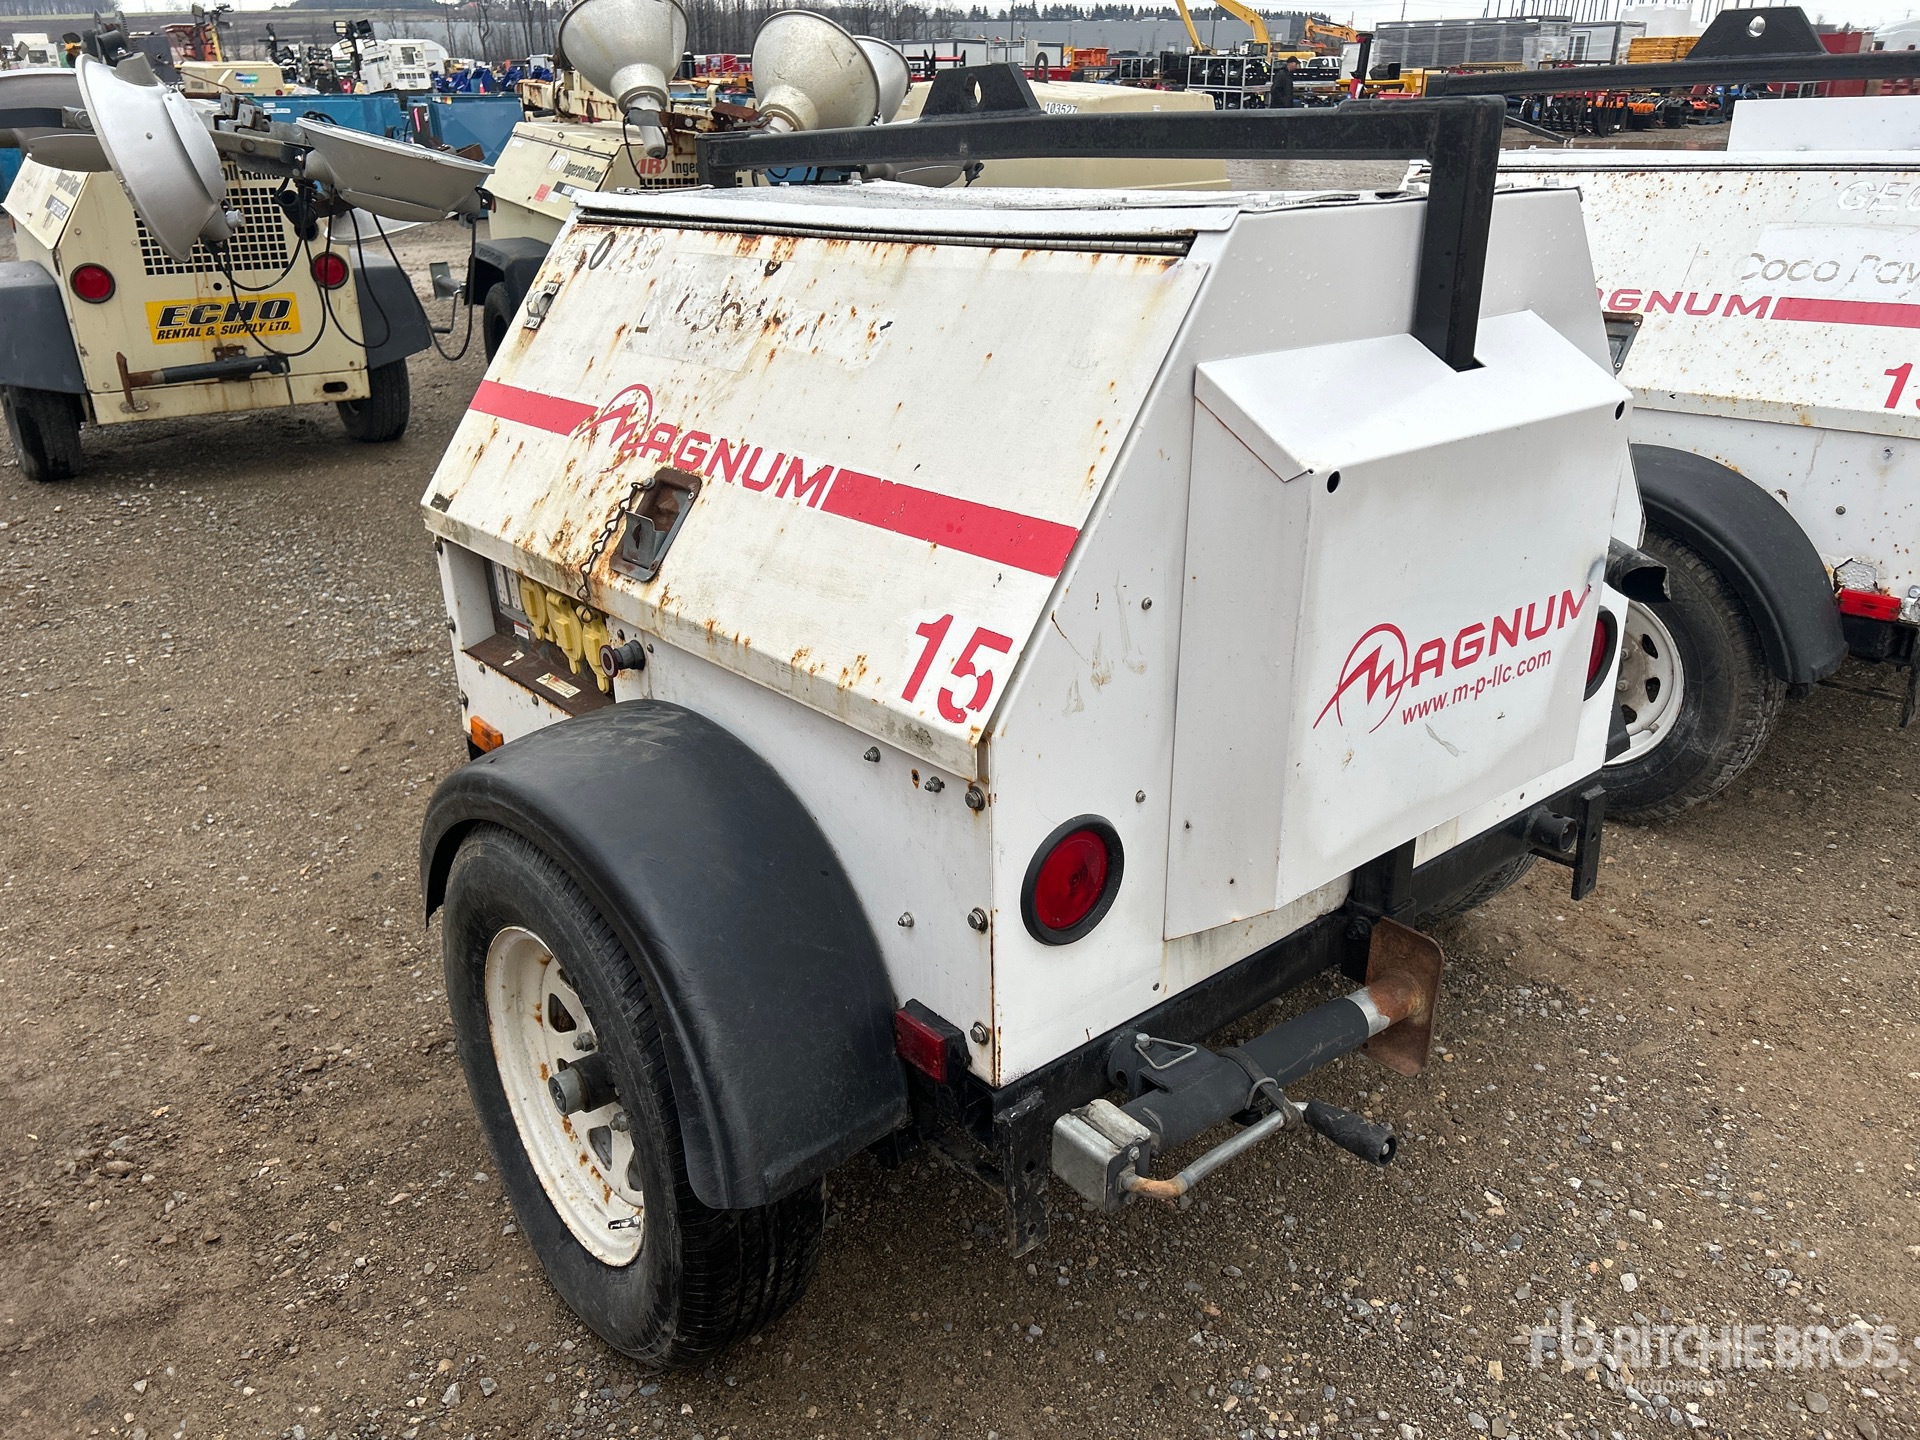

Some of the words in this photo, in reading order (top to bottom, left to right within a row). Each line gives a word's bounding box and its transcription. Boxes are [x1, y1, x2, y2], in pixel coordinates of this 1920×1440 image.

[1045, 103, 1077, 114] 103527
[156, 298, 292, 329] ECHO
[1596, 288, 1772, 320] GNUM
[156, 327, 201, 340] RENTAL
[205, 326, 216, 336] &
[220, 322, 266, 335] SUPPLY
[901, 614, 1013, 724] 15
[1403, 650, 1552, 726] www.m-p-llc.com
